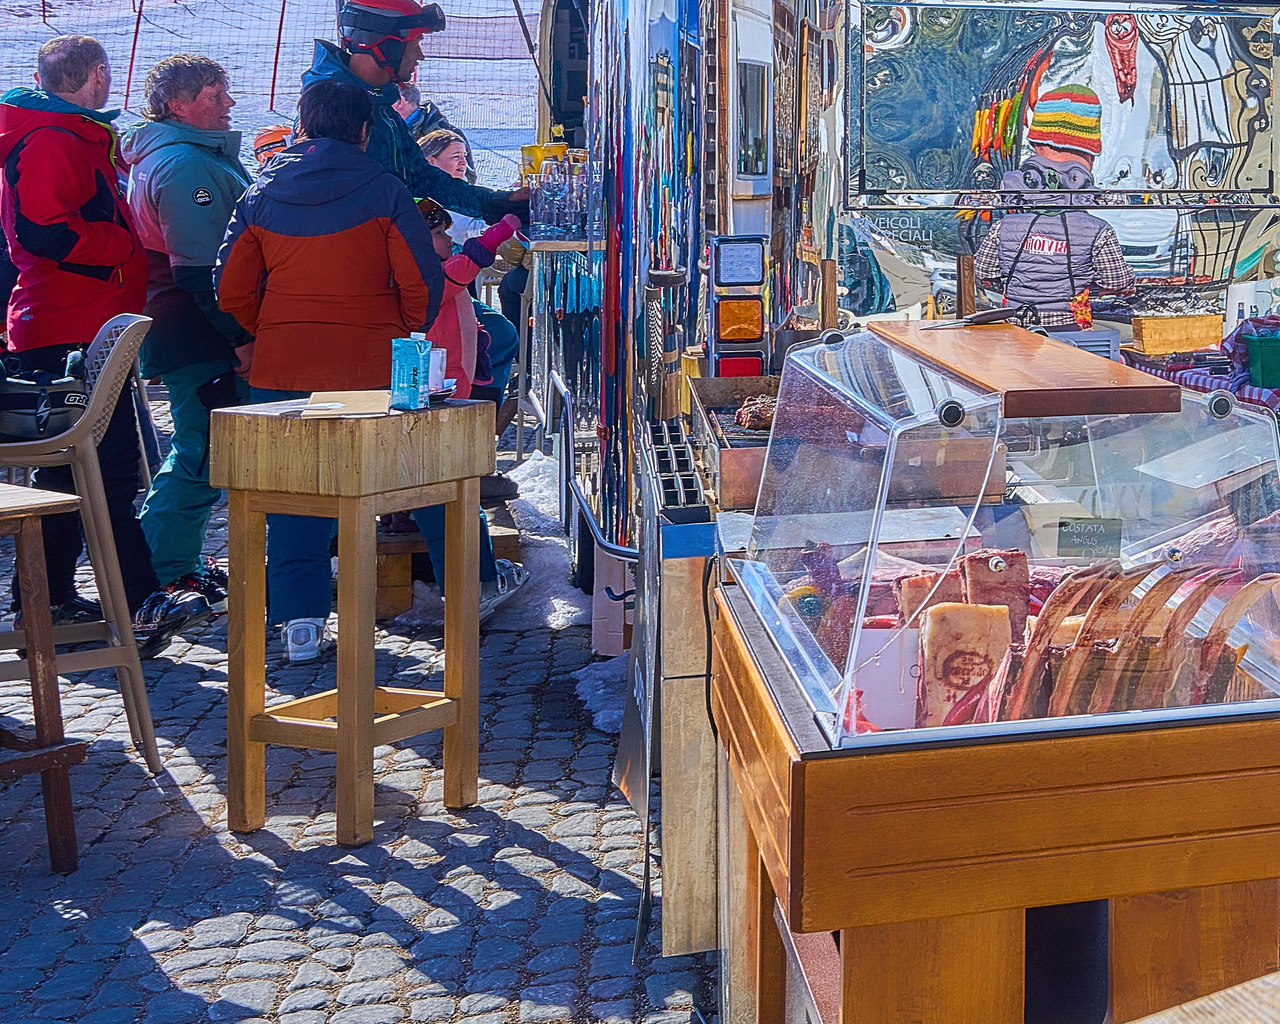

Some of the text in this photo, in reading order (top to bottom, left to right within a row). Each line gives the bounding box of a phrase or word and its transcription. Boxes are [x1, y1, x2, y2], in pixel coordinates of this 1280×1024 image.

[869, 217, 921, 229] VEICOLI
[876, 229, 933, 242] SPECIALI
[1062, 522, 1106, 534] COSTATA
[1069, 534, 1098, 546] ANGUS
